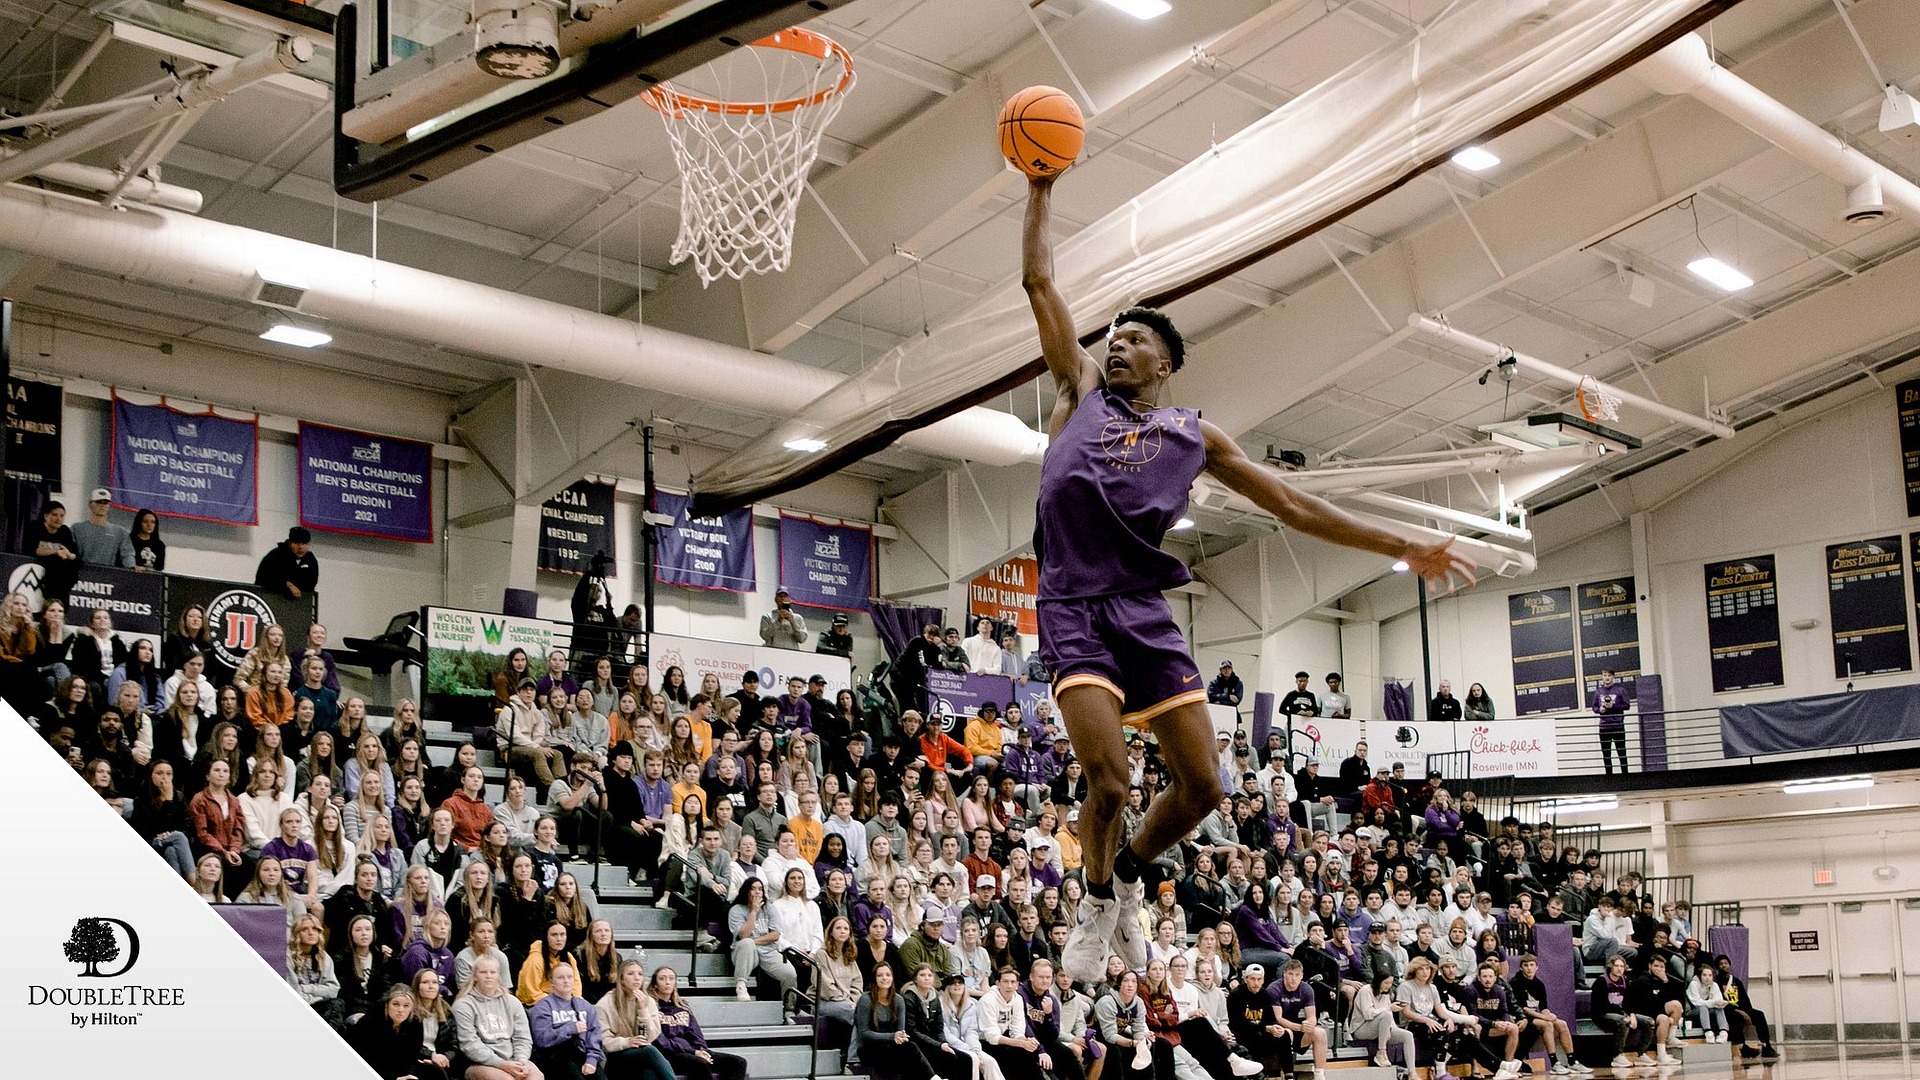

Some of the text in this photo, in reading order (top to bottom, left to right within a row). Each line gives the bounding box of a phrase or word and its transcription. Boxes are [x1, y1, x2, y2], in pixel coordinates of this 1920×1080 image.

[127, 435, 244, 465] NATIONAL CHAMPIONS
[133, 452, 236, 479] MEN'S BASKETBALL
[308, 457, 423, 484] NATIONAL CHAMPIONS
[160, 471, 206, 489] DIVISION
[315, 473, 417, 498] MEN'S BASKETBALL
[341, 493, 387, 508] DIVISION
[550, 489, 588, 507] CCAA
[354, 509, 377, 522] 2021
[564, 510, 605, 526] CHAMPIONS
[546, 526, 589, 543] WRESTLING
[678, 527, 730, 546] VICTORY BOWL
[558, 547, 581, 560] 1992
[684, 543, 723, 560] CHAMPION
[694, 559, 715, 572] 2000
[803, 557, 851, 574] VICTORY BOWL
[1832, 552, 1896, 570] CROSS COUNTRY
[808, 570, 848, 586] CHAMPIONS
[1710, 570, 1770, 588] CROSS COUNTRY
[71, 580, 114, 596] UMMIT
[68, 594, 152, 616] RTHOPEDICS
[972, 584, 1037, 610] TRACK CHAMPION
[208, 595, 240, 629] JIMMY
[436, 612, 473, 624] WOLCYN
[224, 611, 258, 651] JJ
[432, 622, 475, 634] TREE FARMS
[440, 633, 474, 643] NURSERY
[694, 657, 750, 671] COLD STONE
[828, 680, 848, 691] DIO
[1470, 731, 1541, 755] Chick-fil-A
[1384, 750, 1427, 760] DOUBLETR
[1472, 761, 1538, 772] Roseville (MN)
